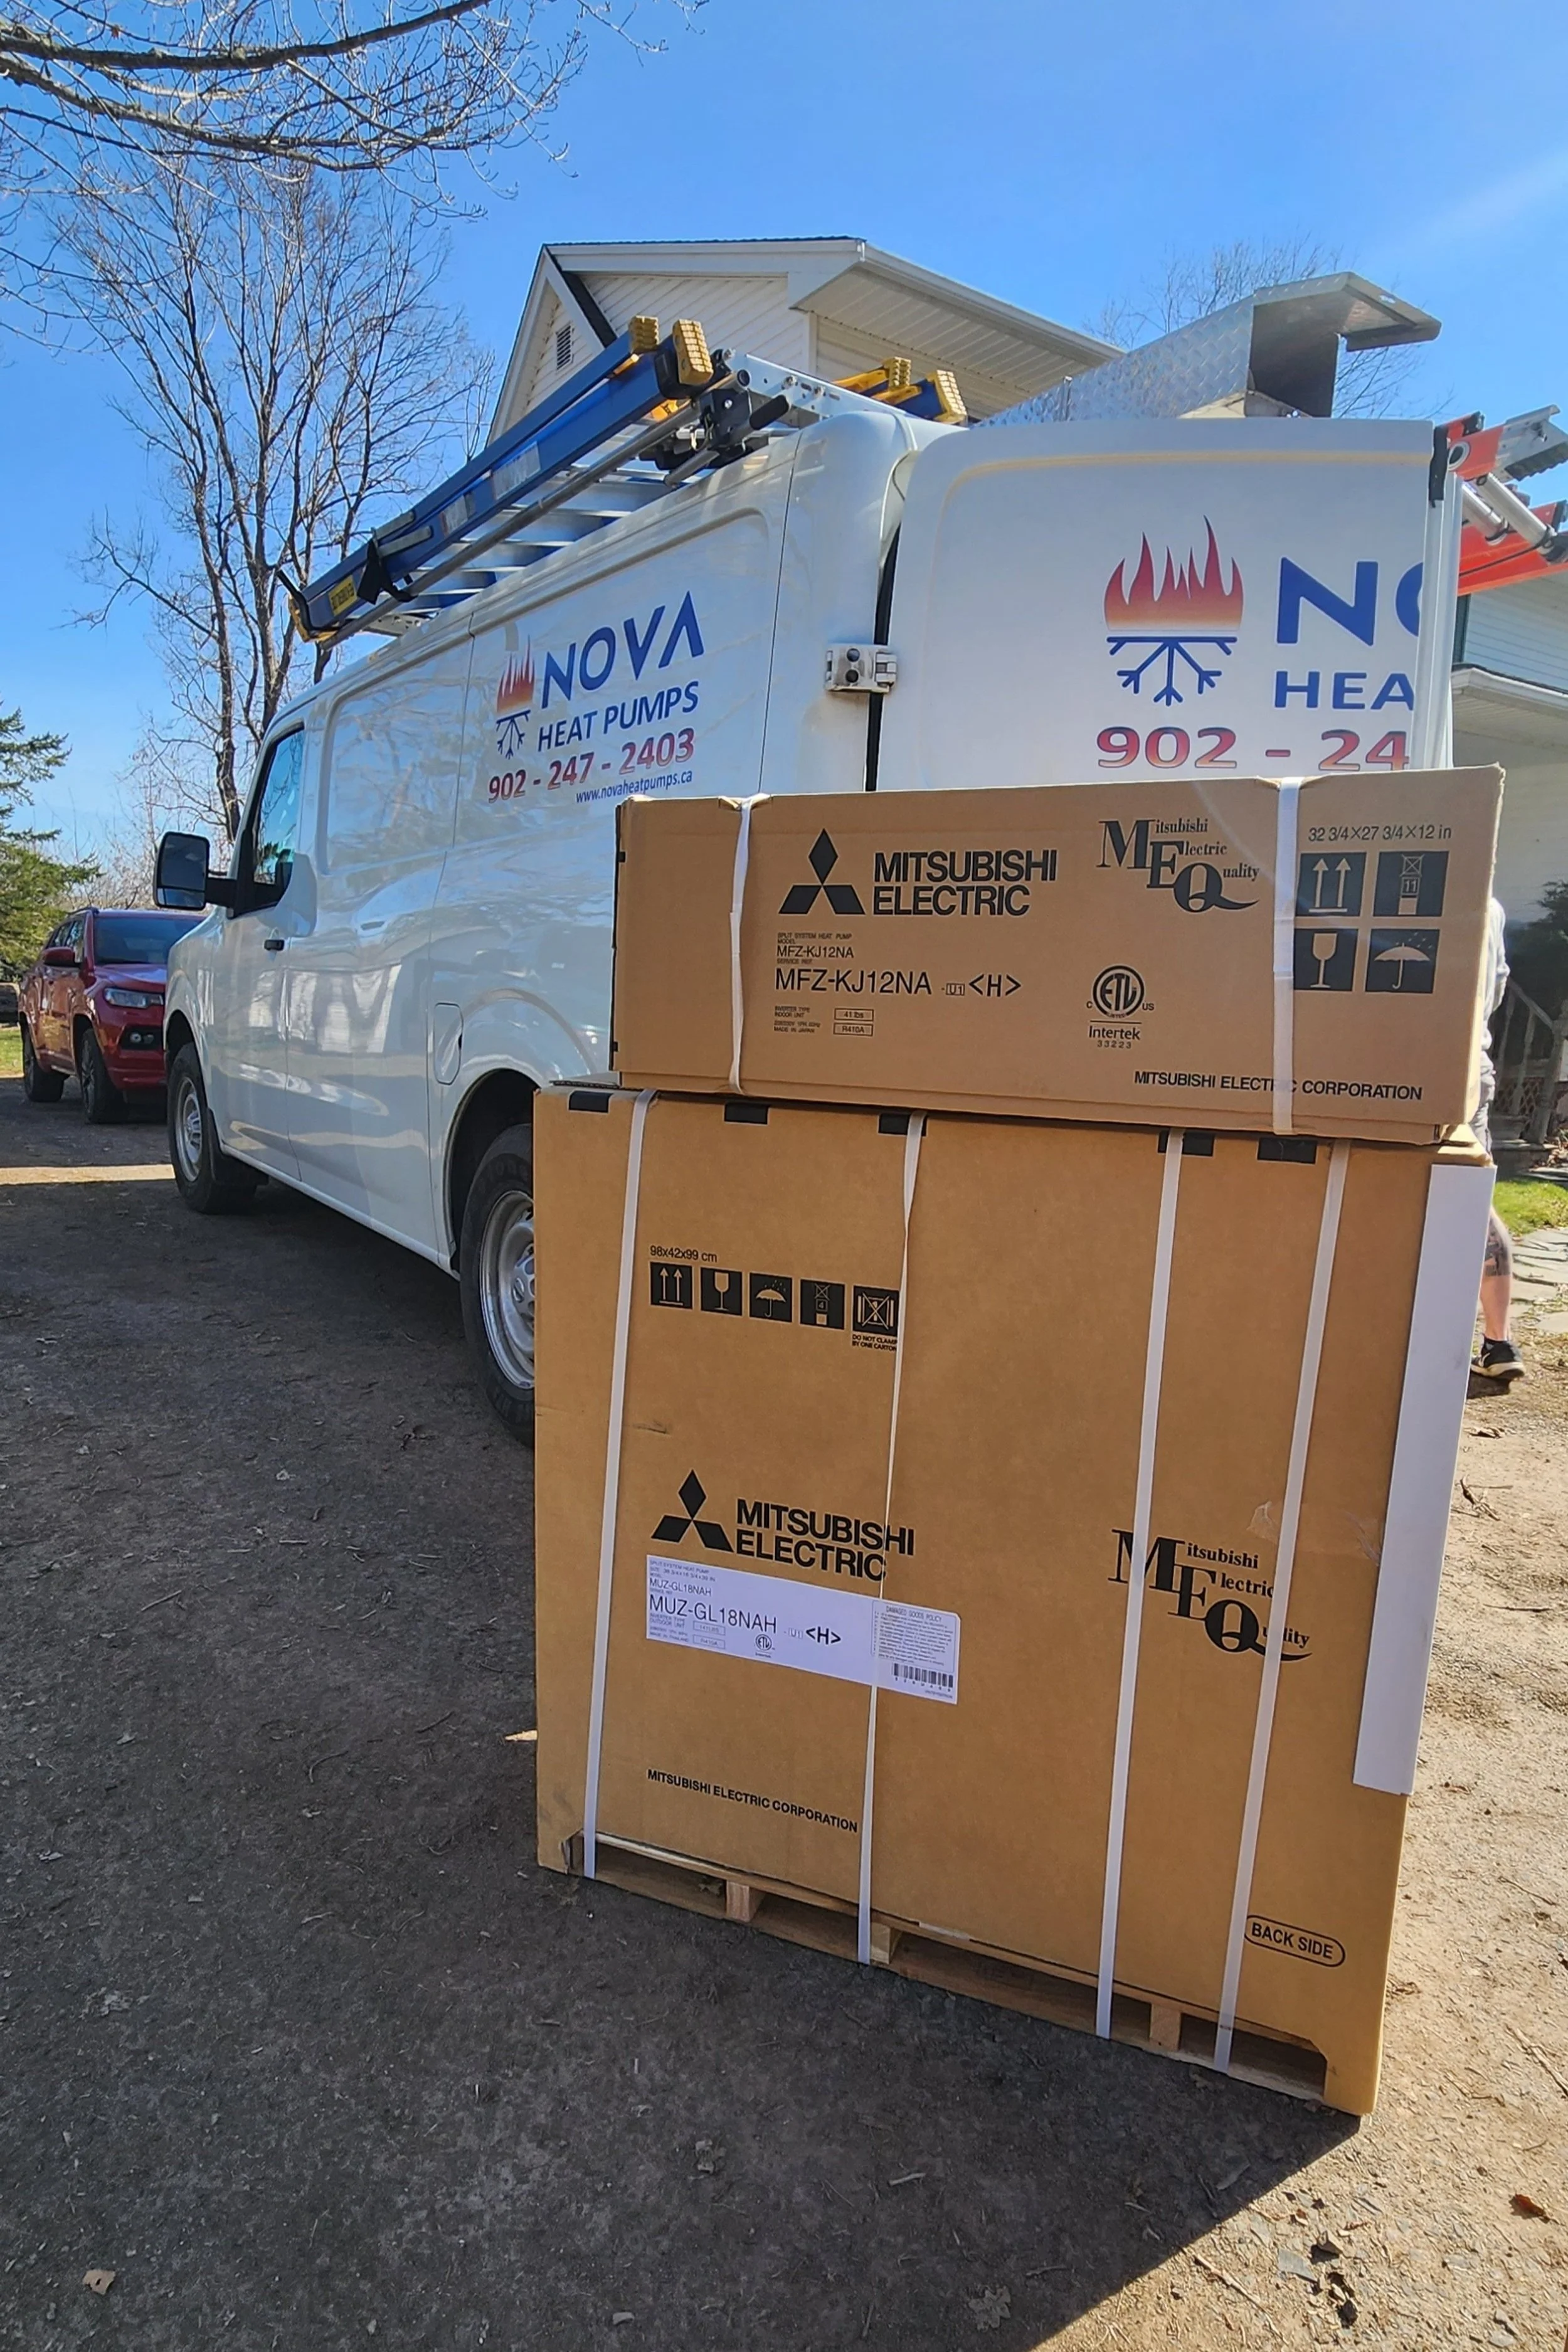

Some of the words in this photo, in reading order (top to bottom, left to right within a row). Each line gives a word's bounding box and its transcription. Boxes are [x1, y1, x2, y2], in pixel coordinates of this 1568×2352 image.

[1276, 557, 1424, 646] N
[542, 591, 704, 709] NOVA
[538, 711, 598, 752] HEAT
[603, 681, 699, 734] PUMPS
[488, 769, 526, 803] 902
[547, 751, 595, 790] 247
[618, 728, 695, 775] 2403
[1096, 726, 1237, 770] 902
[1318, 729, 1410, 772] 24
[576, 770, 692, 803] www.novaheatpumps.ca
[1308, 827, 1326, 842] 32
[1438, 824, 1452, 839] in
[874, 849, 1057, 883] MITSUBISHI
[873, 884, 1030, 916] ELECTRIC
[777, 945, 854, 958] MFZ-KJ12NA
[775, 968, 932, 995] MFZ-KJ12NA
[842, 1025, 864, 1034] R410A
[1089, 1025, 1141, 1041] Intertek
[1097, 1040, 1131, 1049] 33223
[1134, 1070, 1216, 1088] MITSUBISHI
[1302, 1079, 1423, 1099] CORPORATION
[649, 1245, 699, 1261] 98x42x99
[701, 1251, 718, 1263] cm
[736, 1498, 914, 1556] MITSUBISHI
[736, 1529, 887, 1582] ELECTRIC
[650, 1577, 712, 1596] MUZ-GL18NAH
[650, 1594, 776, 1634] MUZ-GL18NAH
[886, 1606, 907, 1616] DAMAGED
[909, 1610, 924, 1619] GOODS
[926, 1614, 942, 1622] POLICY
[647, 1769, 711, 1794] MITSUBISHI
[714, 1785, 770, 1808] ELECTRIC
[772, 1801, 858, 1833] CORPORATION
[1251, 1922, 1295, 1948] BACK
[1297, 1936, 1333, 1960] SIDE
